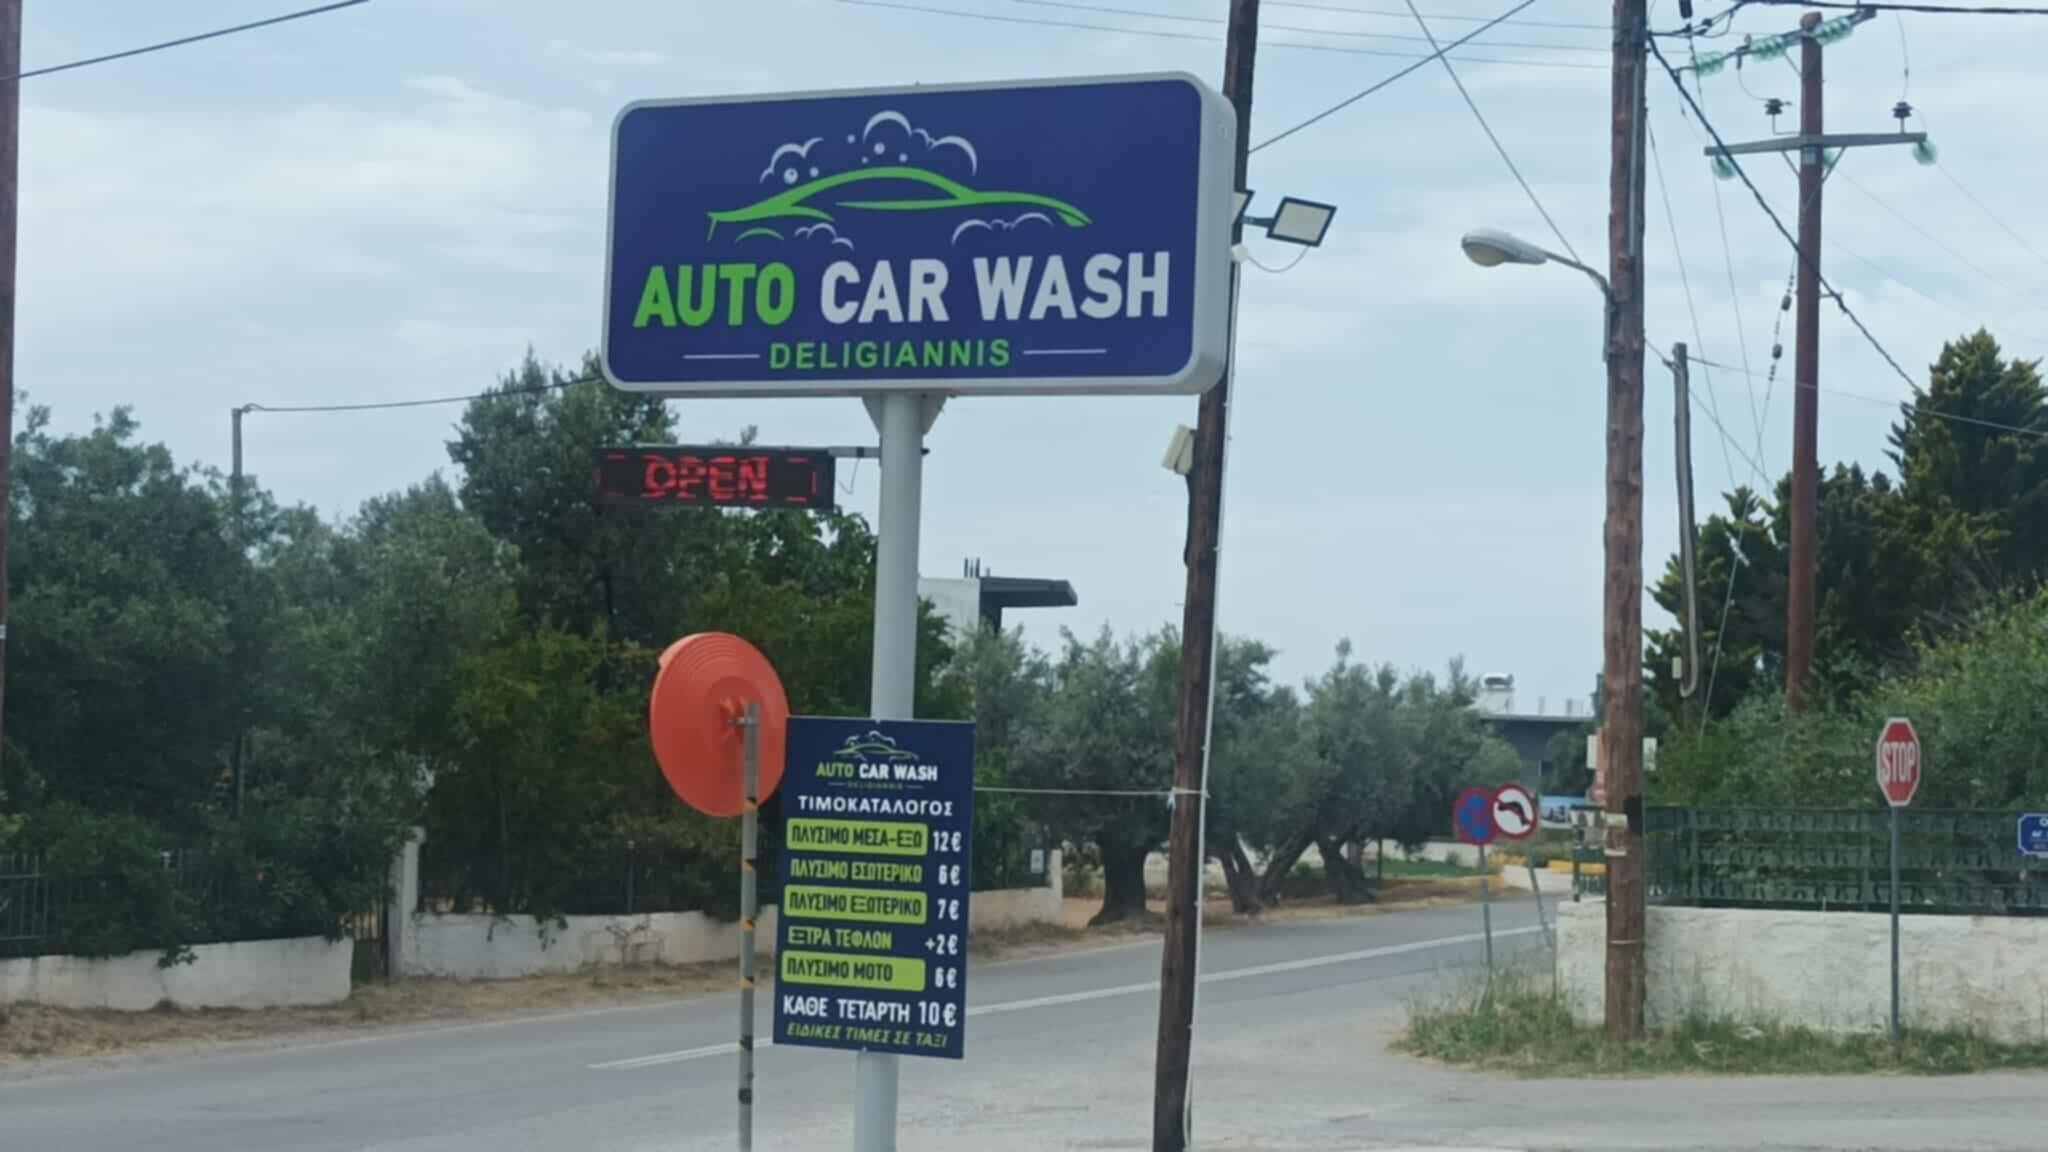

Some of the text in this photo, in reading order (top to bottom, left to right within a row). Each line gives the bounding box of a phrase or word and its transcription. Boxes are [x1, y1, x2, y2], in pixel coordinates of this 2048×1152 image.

[632, 251, 1171, 328] AUTO CAR WASH
[769, 338, 1011, 370] DELIGIANNIS
[641, 455, 769, 501] OPEN
[816, 762, 938, 781] AUTO CAR WASH
[1881, 741, 1917, 785] STOP
[798, 795, 953, 816] ΤΙΜΟΚΑΤΑΛΟΓΟΣ
[792, 825, 848, 845] ΠΛΥΣΙΜΟ
[790, 858, 848, 879] ΠΛΥΣΙΜΟ
[852, 861, 922, 883] ΕΣΩΤΕΡΙΚΟ
[789, 891, 847, 912] ΠΛΥΣΙΜΟ
[850, 894, 921, 916] ΕΞΩΤΕΡΙΚΟ
[788, 926, 832, 946] ΕΞΤΡΑ
[835, 928, 892, 950] ΤΕΦΛΟΝ
[787, 958, 849, 979] ΠΛΥΣΙΜΟ
[853, 963, 893, 982] ΜΟΤΟ
[783, 995, 828, 1017] ΚΑΘΕ
[837, 999, 910, 1023] ΤΕΤΑΡΤΗ
[787, 1022, 841, 1040] ΕΙΔΙΚΕΣ
[846, 1026, 889, 1044] ΤΙΜΕΣ
